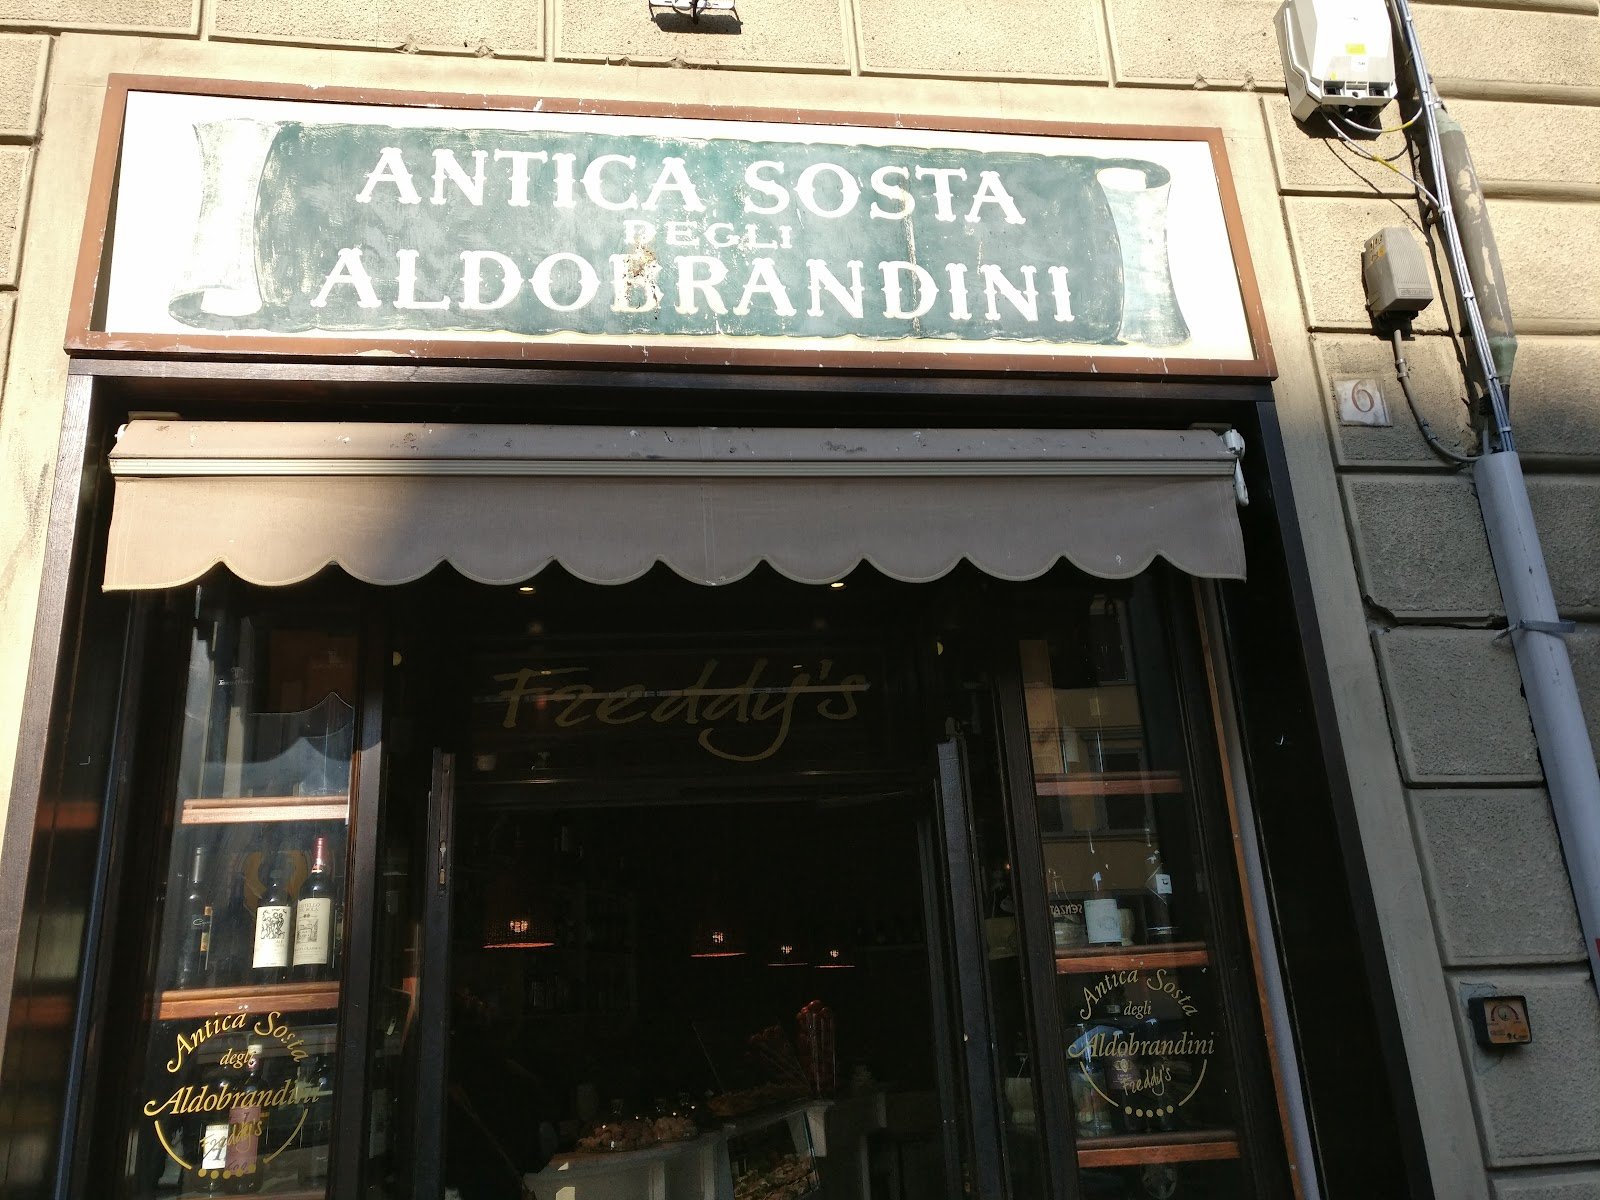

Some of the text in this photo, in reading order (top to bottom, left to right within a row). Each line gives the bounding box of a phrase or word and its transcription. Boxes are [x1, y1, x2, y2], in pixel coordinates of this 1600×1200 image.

[355, 146, 1027, 225] ANTICA SOSTA
[622, 219, 794, 250] DEGLI
[310, 247, 1076, 323] ALDOBRANDINI
[1351, 379, 1375, 413] 6
[493, 657, 867, 762] Freddy's
[1080, 967, 1199, 1020] Antica Sosta
[1123, 1000, 1152, 1020] degli
[166, 1011, 309, 1073] Antica Sosta
[1067, 1031, 1215, 1059] Aldobrandini
